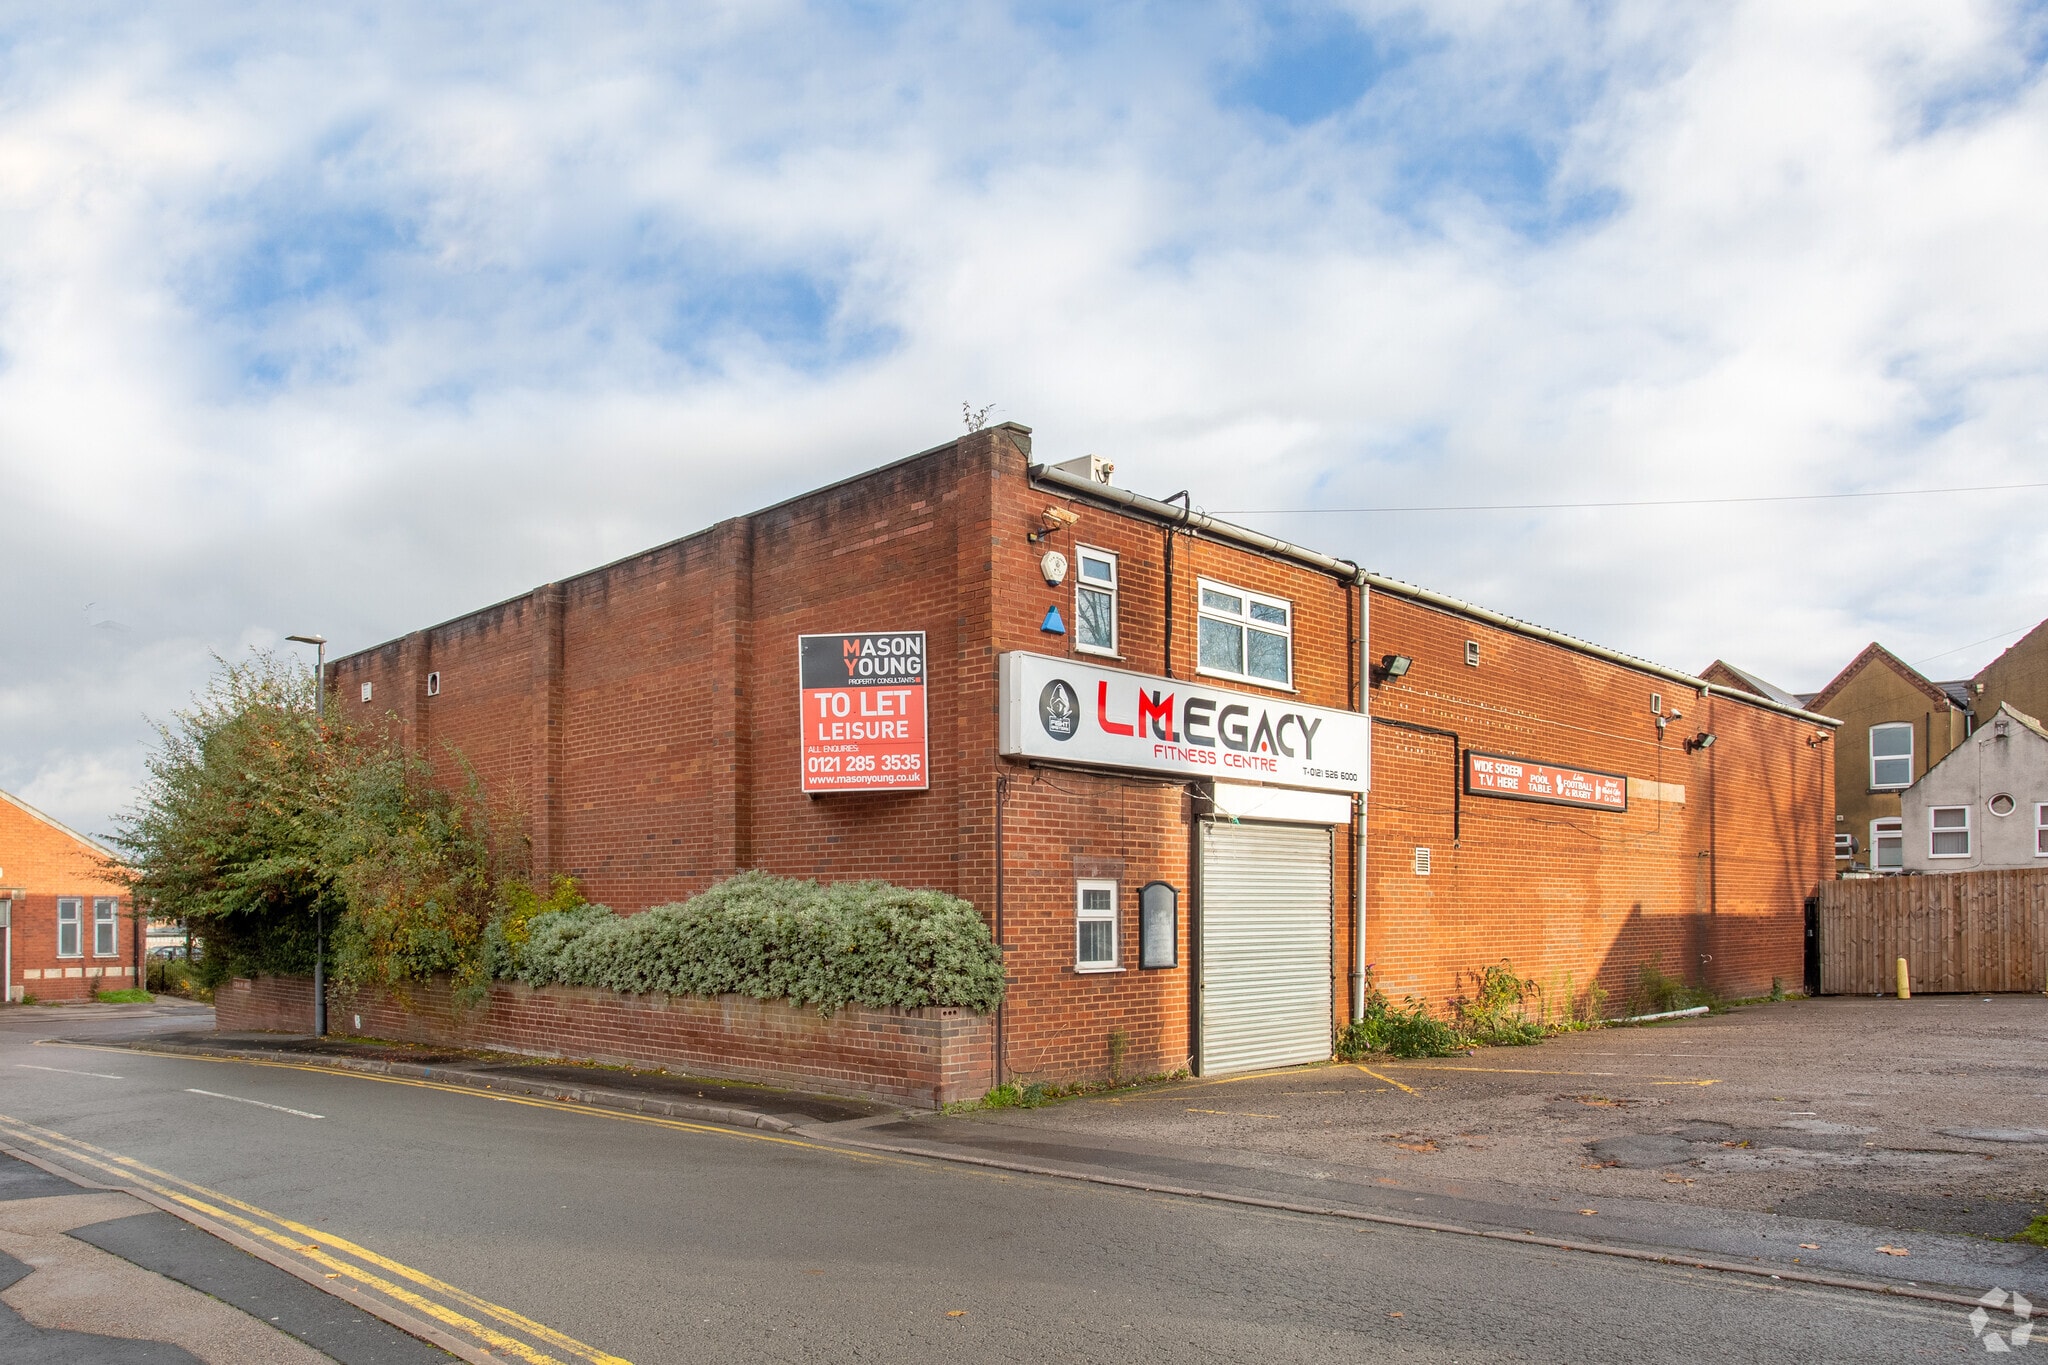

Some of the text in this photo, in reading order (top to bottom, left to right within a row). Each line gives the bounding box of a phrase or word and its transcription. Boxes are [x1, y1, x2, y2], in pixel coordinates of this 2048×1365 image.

[843, 637, 920, 657] MASON
[844, 657, 921, 676] YOUNG
[814, 690, 911, 718] TO LET
[818, 721, 909, 741] LEISURE
[808, 754, 921, 773] 0121 285 3535
[1153, 744, 1278, 773] FITNESS CENTRE
[1325, 769, 1338, 779] 526
[1340, 771, 1358, 782] 6000
[1473, 759, 1523, 777] WIDE SCREEN
[808, 773, 921, 785] www.masonyoung.co.uk
[1478, 773, 1519, 789] T.V. HERE
[1530, 774, 1550, 785] POOL
[1563, 779, 1594, 792] FOOTBALL
[1527, 782, 1552, 794] TABLE
[1565, 788, 1592, 800] & RUGBY
